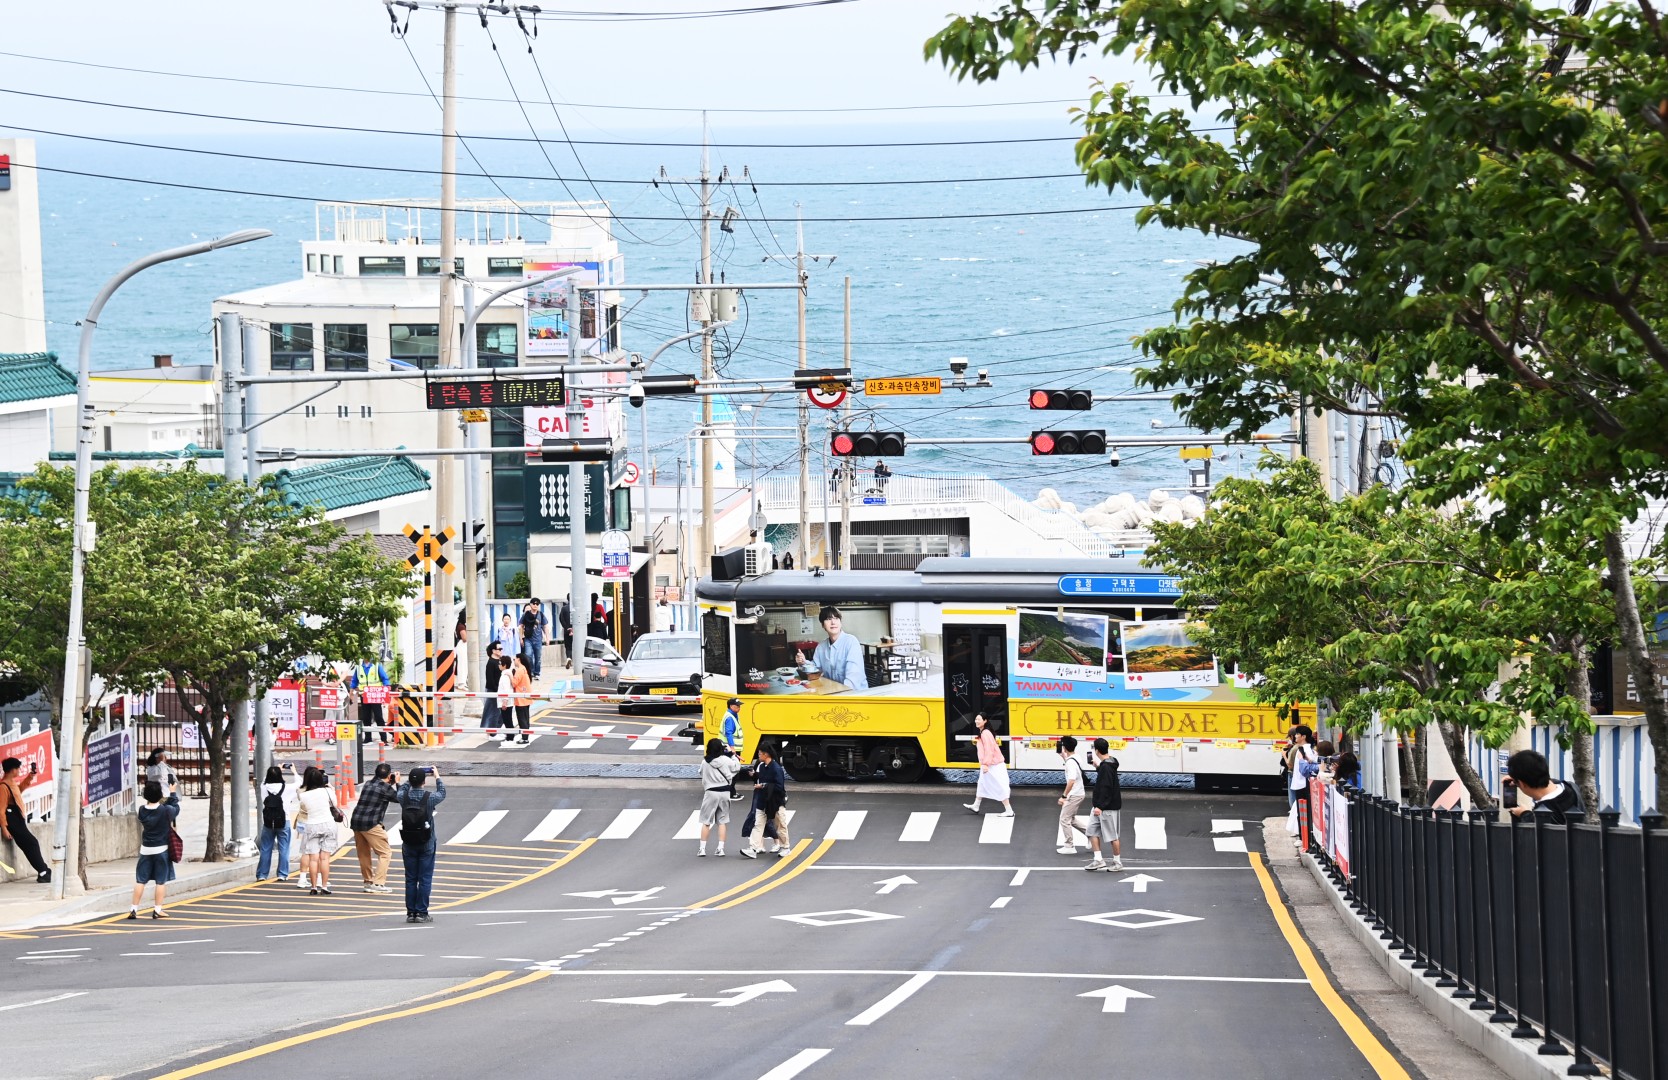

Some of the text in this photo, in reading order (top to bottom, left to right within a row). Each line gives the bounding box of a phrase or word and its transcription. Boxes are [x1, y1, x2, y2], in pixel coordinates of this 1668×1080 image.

[868, 380, 937, 393] 신호·과속단속장비
[442, 384, 471, 405] 단속
[480, 383, 498, 403] 중
[538, 417, 589, 432] CAE
[1075, 578, 1092, 588] 송정
[1112, 578, 1136, 588] 구덕포
[888, 656, 931, 670] 또 만나
[590, 673, 605, 682] Uber
[890, 670, 927, 683] 대만!
[1015, 681, 1073, 692] TAIWAN
[1055, 710, 1221, 734] HAEUNDAE
